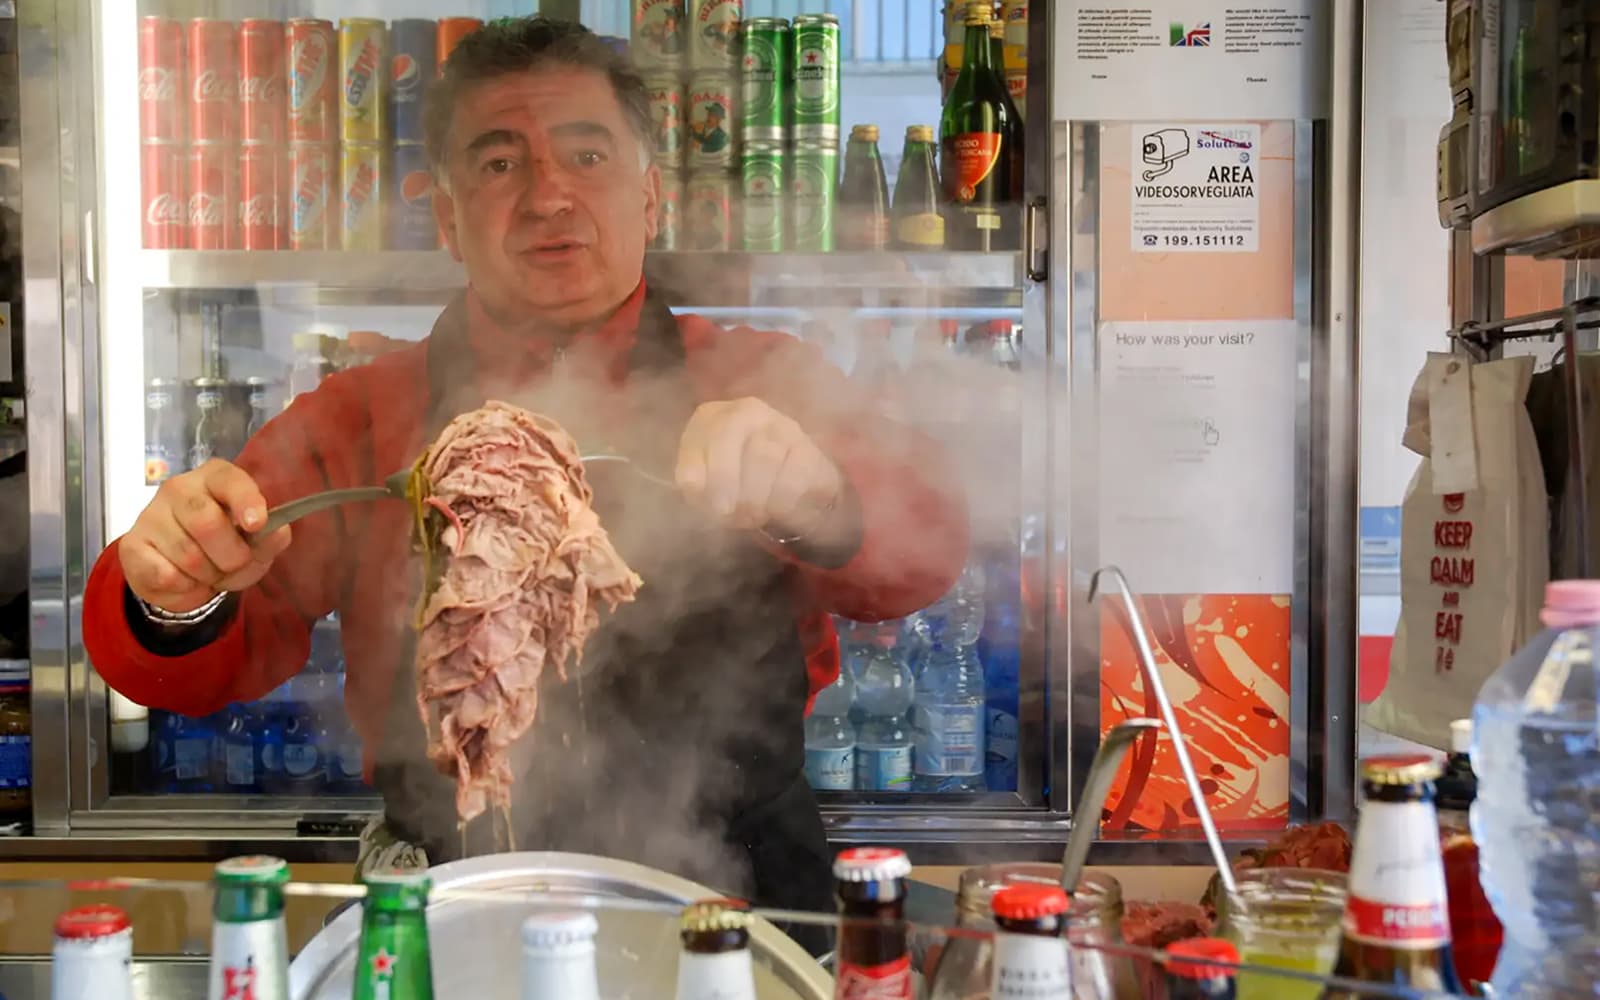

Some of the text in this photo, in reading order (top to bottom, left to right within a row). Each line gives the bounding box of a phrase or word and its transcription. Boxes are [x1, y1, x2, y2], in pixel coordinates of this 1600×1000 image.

[1207, 165, 1254, 183] AREA
[1135, 185, 1254, 198] VIDEOSORVEGLIATA
[1164, 235, 1244, 246] 199.151112
[1116, 332, 1255, 348] How was your visit?
[1434, 520, 1473, 548] KEEP
[1430, 556, 1475, 586] CALM
[1435, 611, 1464, 645] EAT
